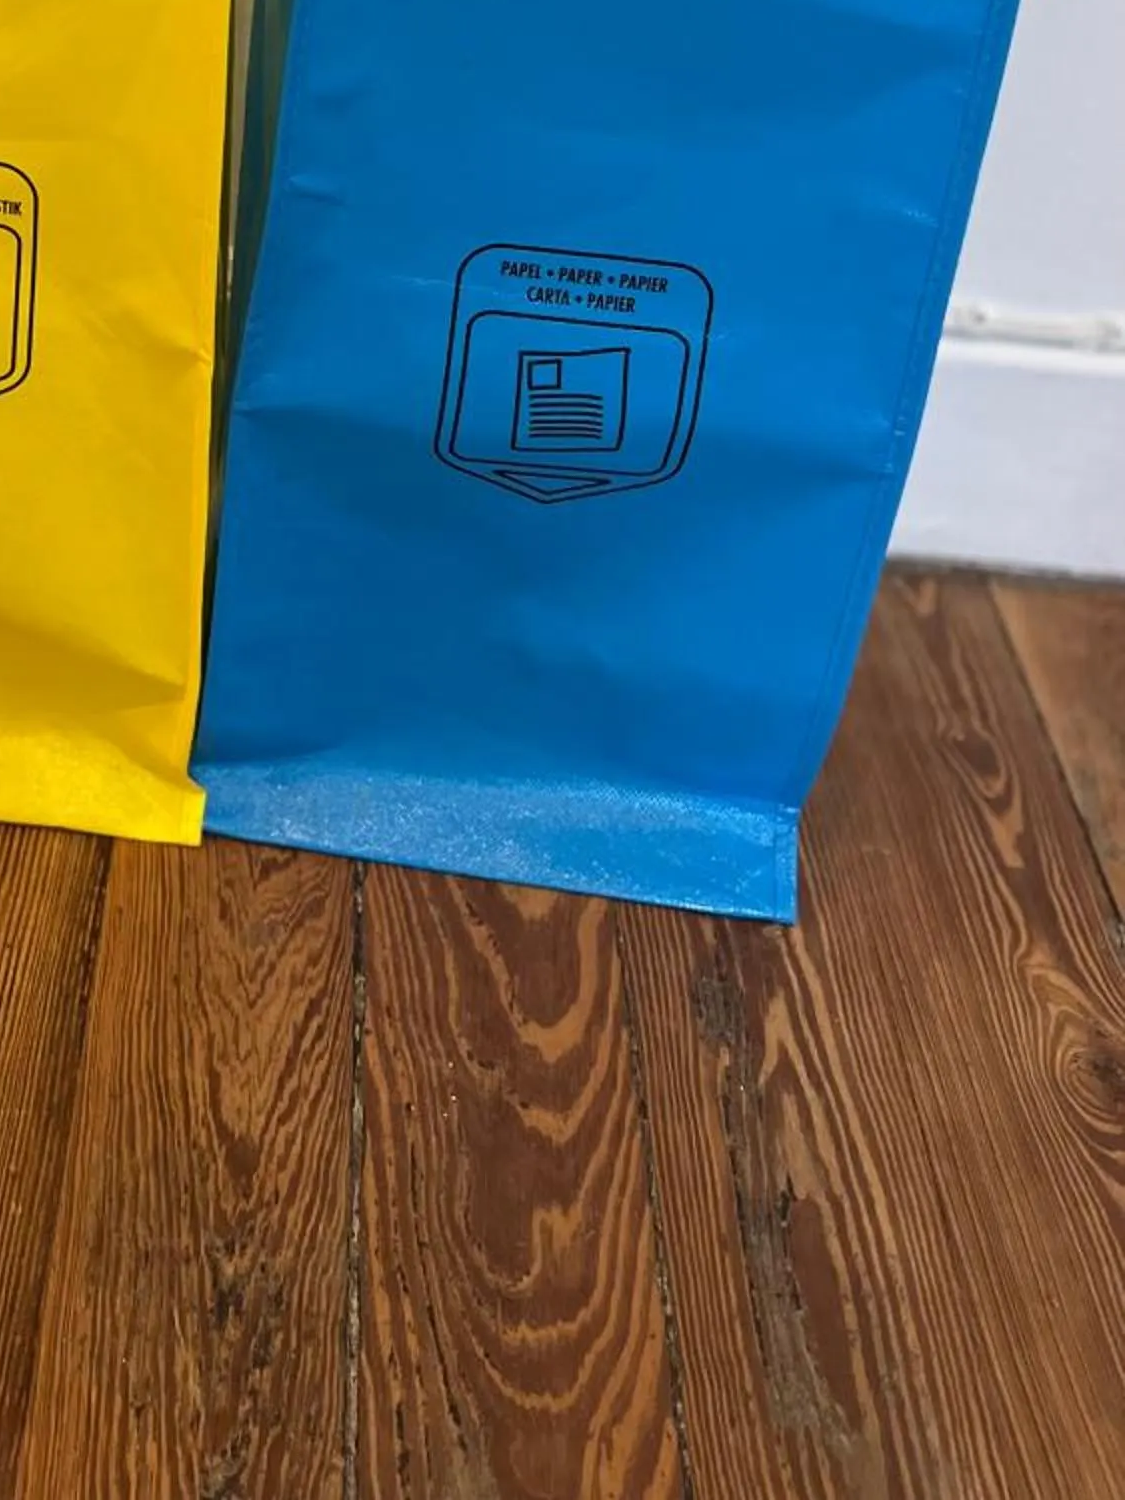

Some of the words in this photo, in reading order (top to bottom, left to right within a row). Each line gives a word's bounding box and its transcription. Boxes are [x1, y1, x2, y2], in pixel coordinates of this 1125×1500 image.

[499, 260, 542, 278] PAPEL
[557, 266, 604, 286] PAPER
[618, 273, 669, 293] PAPIER
[526, 286, 571, 306] CARTA
[586, 293, 636, 313] PAPIER
